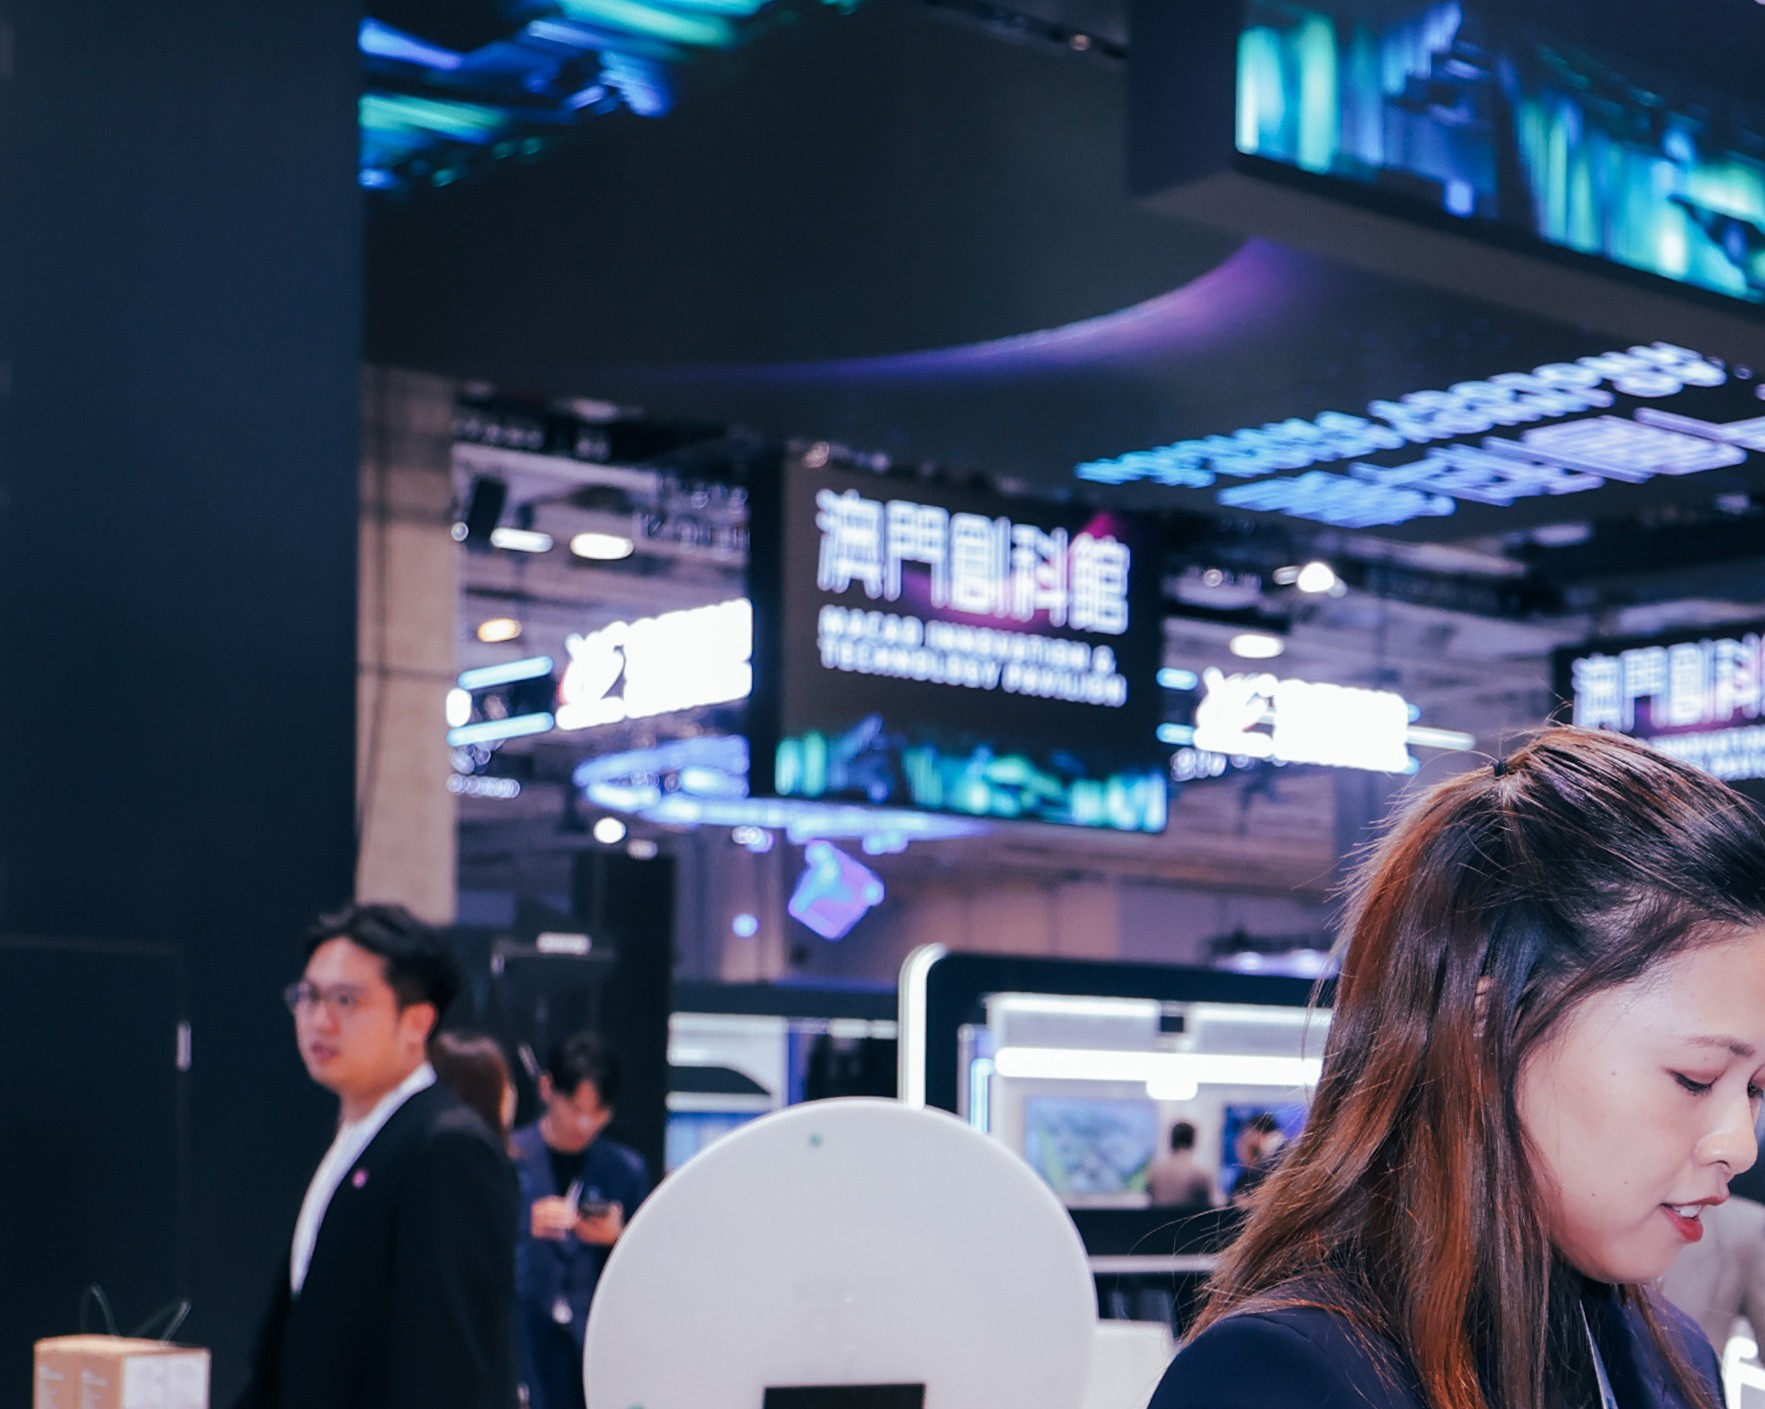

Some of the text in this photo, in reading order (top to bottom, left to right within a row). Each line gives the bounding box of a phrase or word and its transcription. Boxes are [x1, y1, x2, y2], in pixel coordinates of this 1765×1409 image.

[816, 488, 1130, 636] 澳門創科館
[818, 604, 1116, 675] MACAO INNOVATION &
[819, 637, 1127, 708] TECHNOLOGY PAVILION
